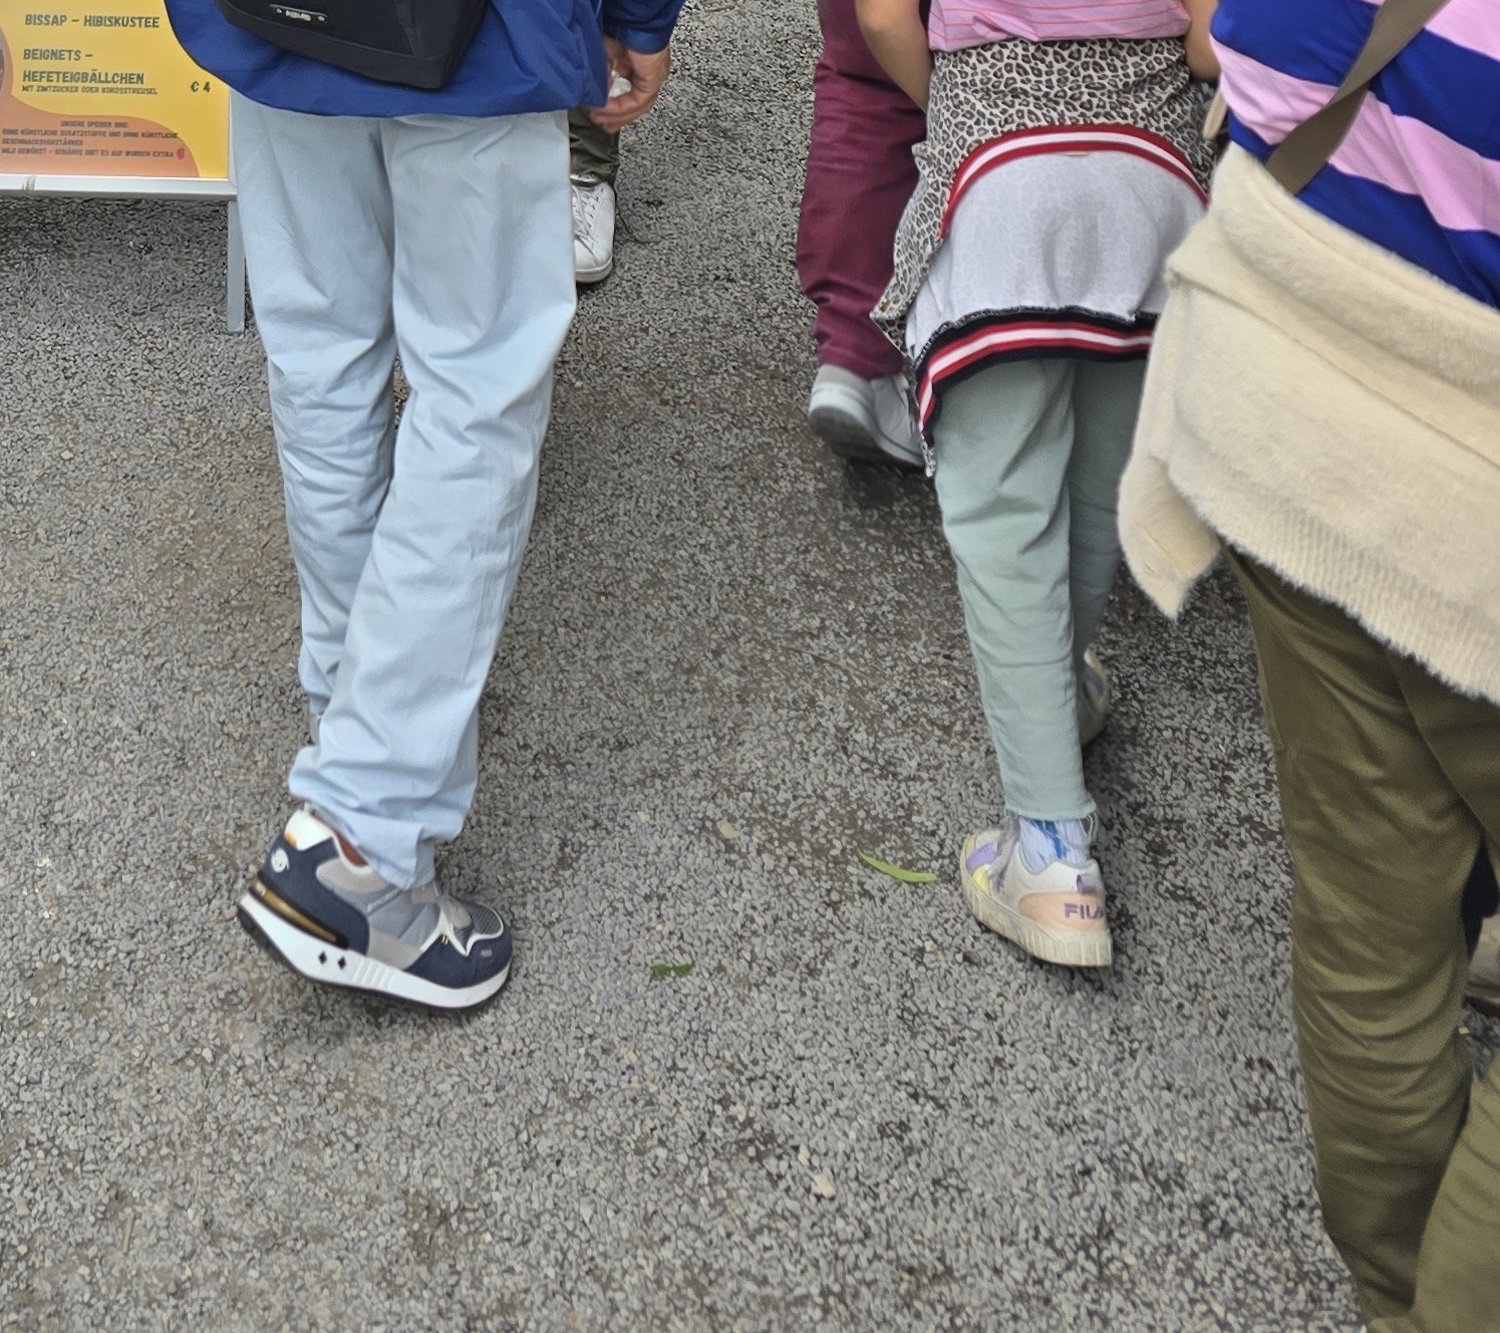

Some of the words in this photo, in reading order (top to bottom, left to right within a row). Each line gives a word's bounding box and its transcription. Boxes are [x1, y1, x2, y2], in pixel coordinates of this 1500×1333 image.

[25, 14, 67, 26] BISSAP
[84, 15, 160, 28] HIBISKUSTEE
[23, 49, 81, 61] BEIGNETS
[23, 69, 144, 84] HEFETEIGBÄLLCHEN
[203, 81, 211, 93] 4
